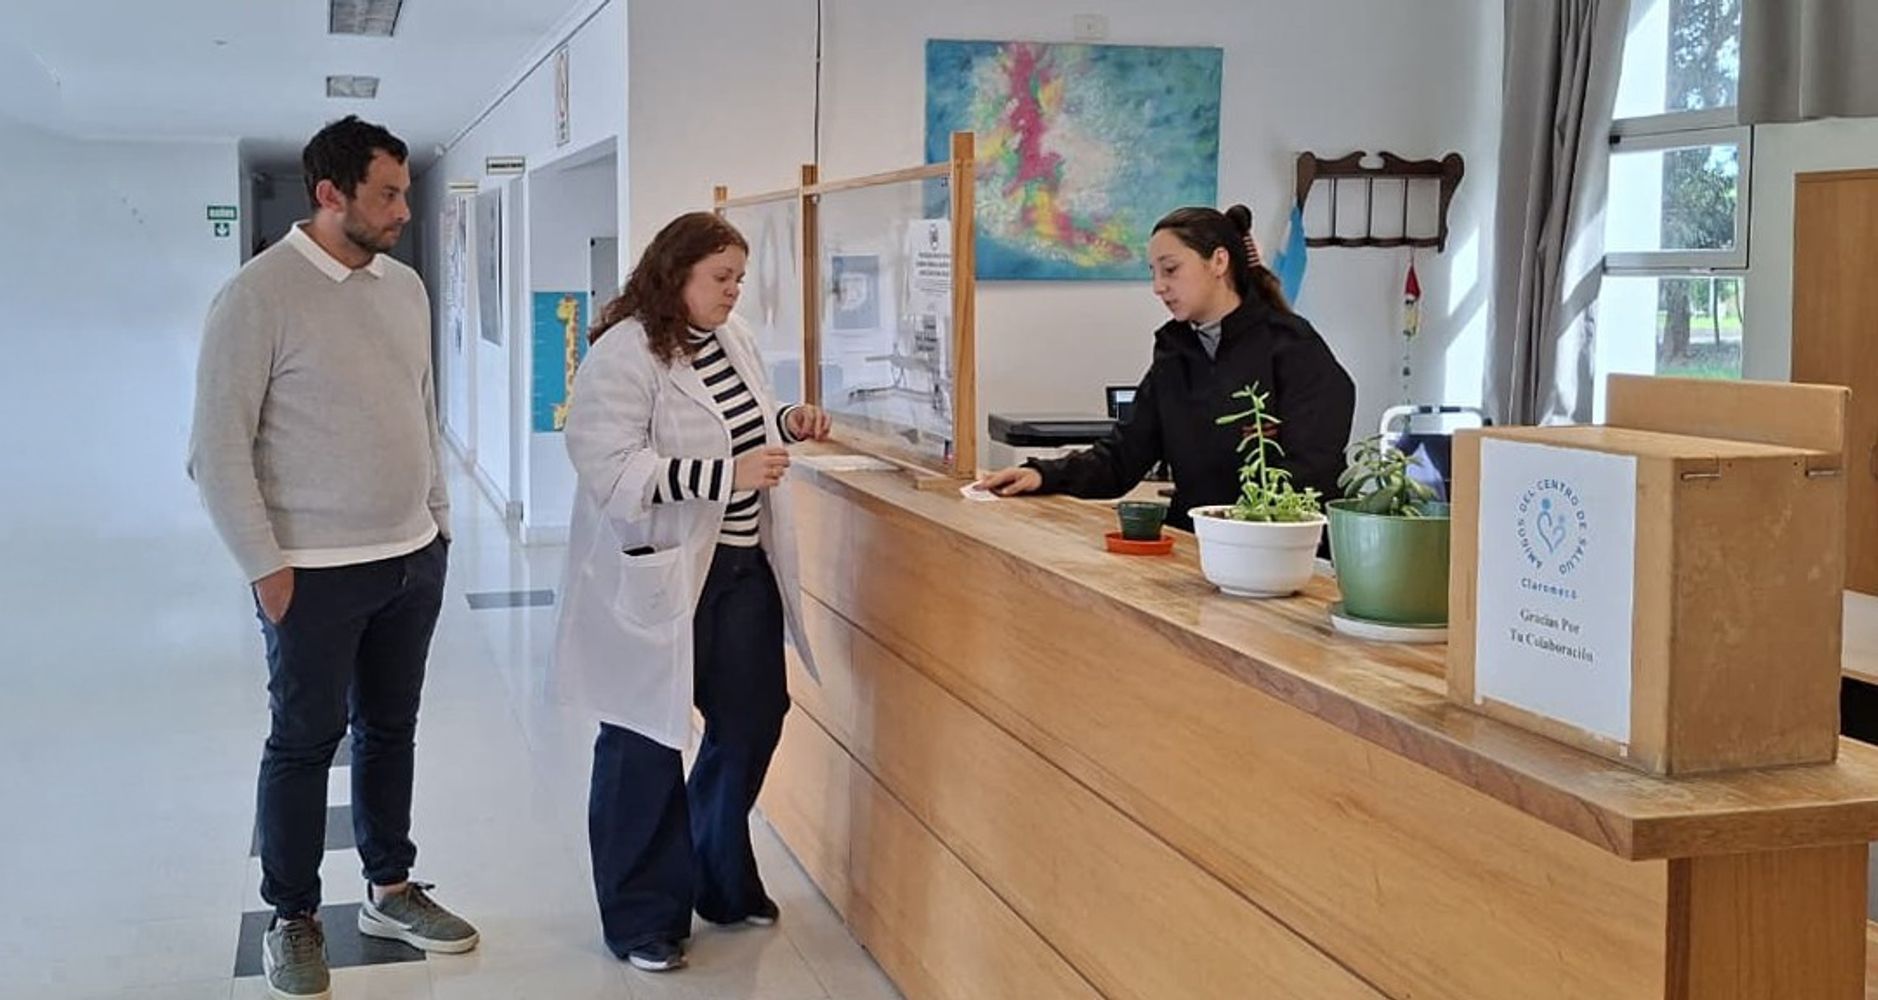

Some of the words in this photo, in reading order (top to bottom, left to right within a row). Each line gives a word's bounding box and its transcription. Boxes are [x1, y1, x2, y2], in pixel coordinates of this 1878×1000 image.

[1519, 487, 1535, 513] DEL
[1536, 479, 1579, 506] CENTRO
[1576, 510, 1587, 529] DE
[1517, 518, 1543, 569] AMIGOS
[1559, 538, 1587, 574] SALUD
[1520, 608, 1559, 629] Gracias
[1561, 618, 1580, 634] Por
[1510, 628, 1524, 643] Tu
[1525, 632, 1594, 662] Colaboración
